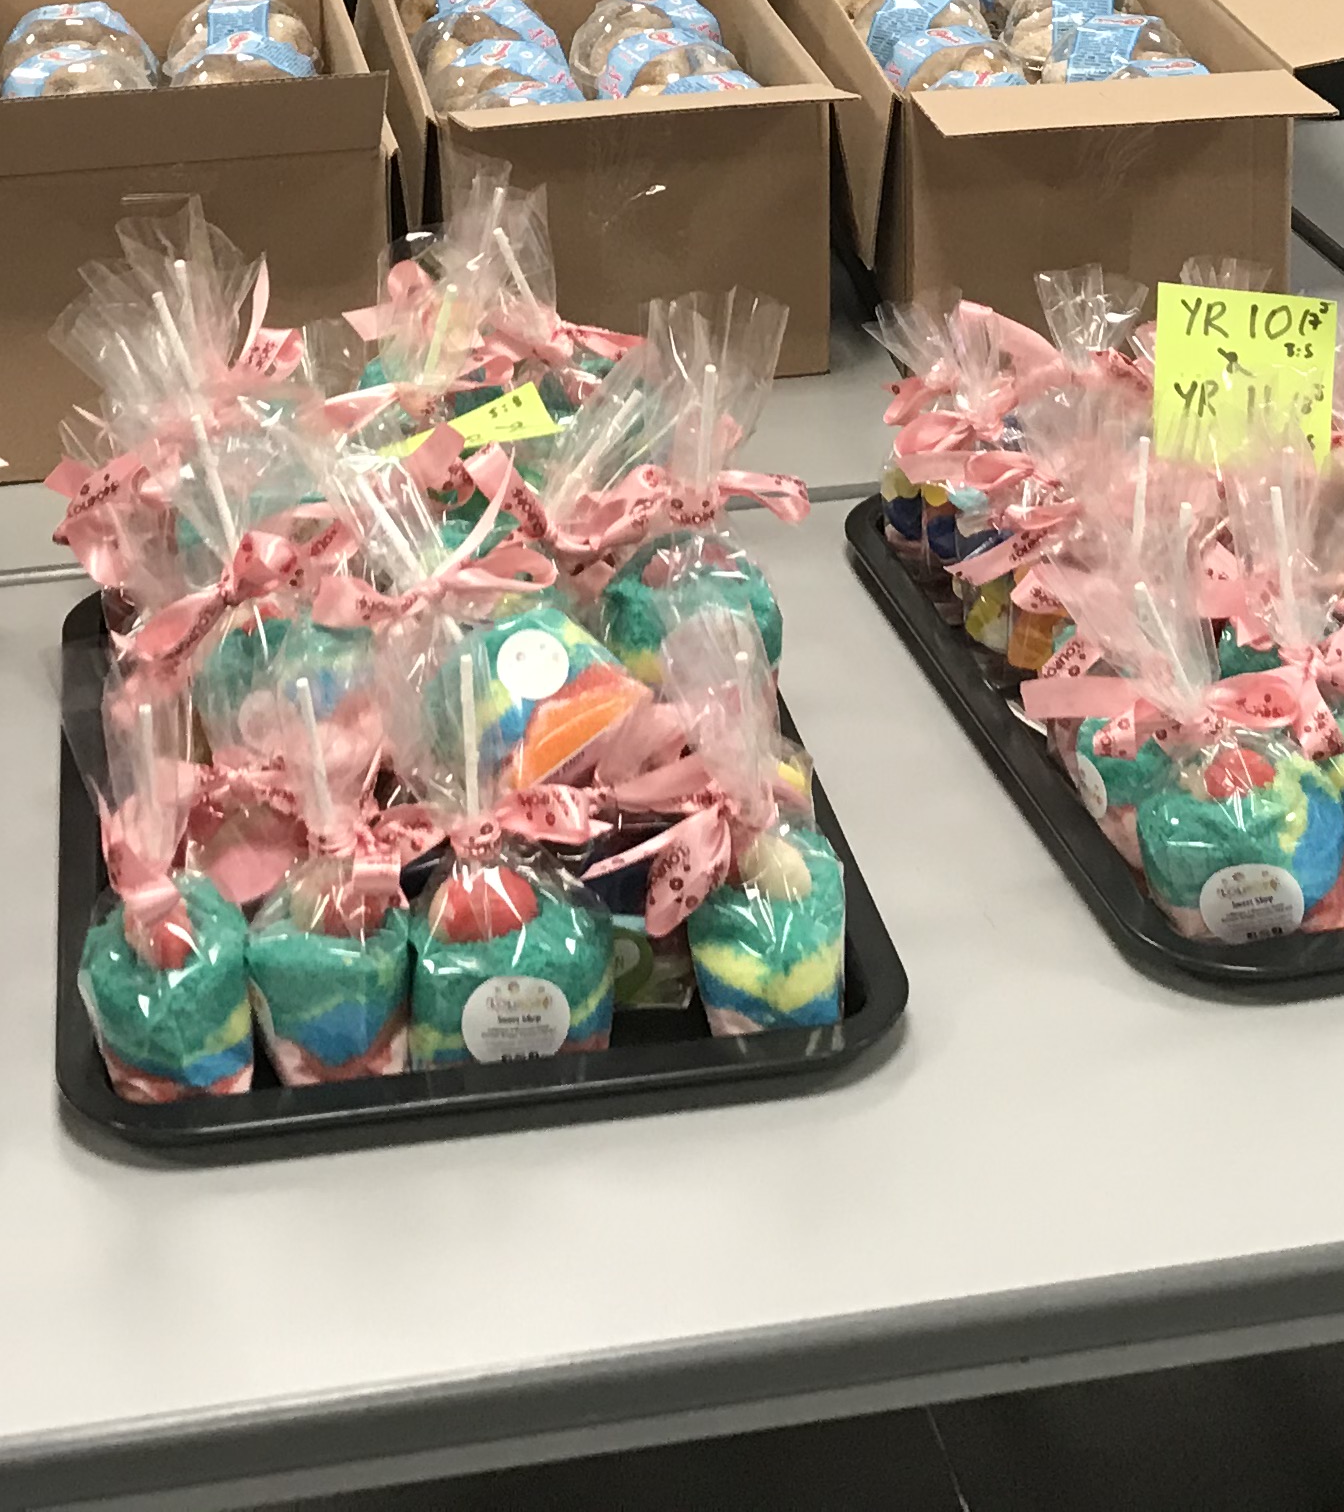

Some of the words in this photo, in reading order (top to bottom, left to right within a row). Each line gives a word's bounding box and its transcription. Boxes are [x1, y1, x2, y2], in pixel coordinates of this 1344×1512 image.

[1181, 298, 1229, 338] YR
[1250, 304, 1292, 340] 10
[1174, 380, 1218, 417] YR
